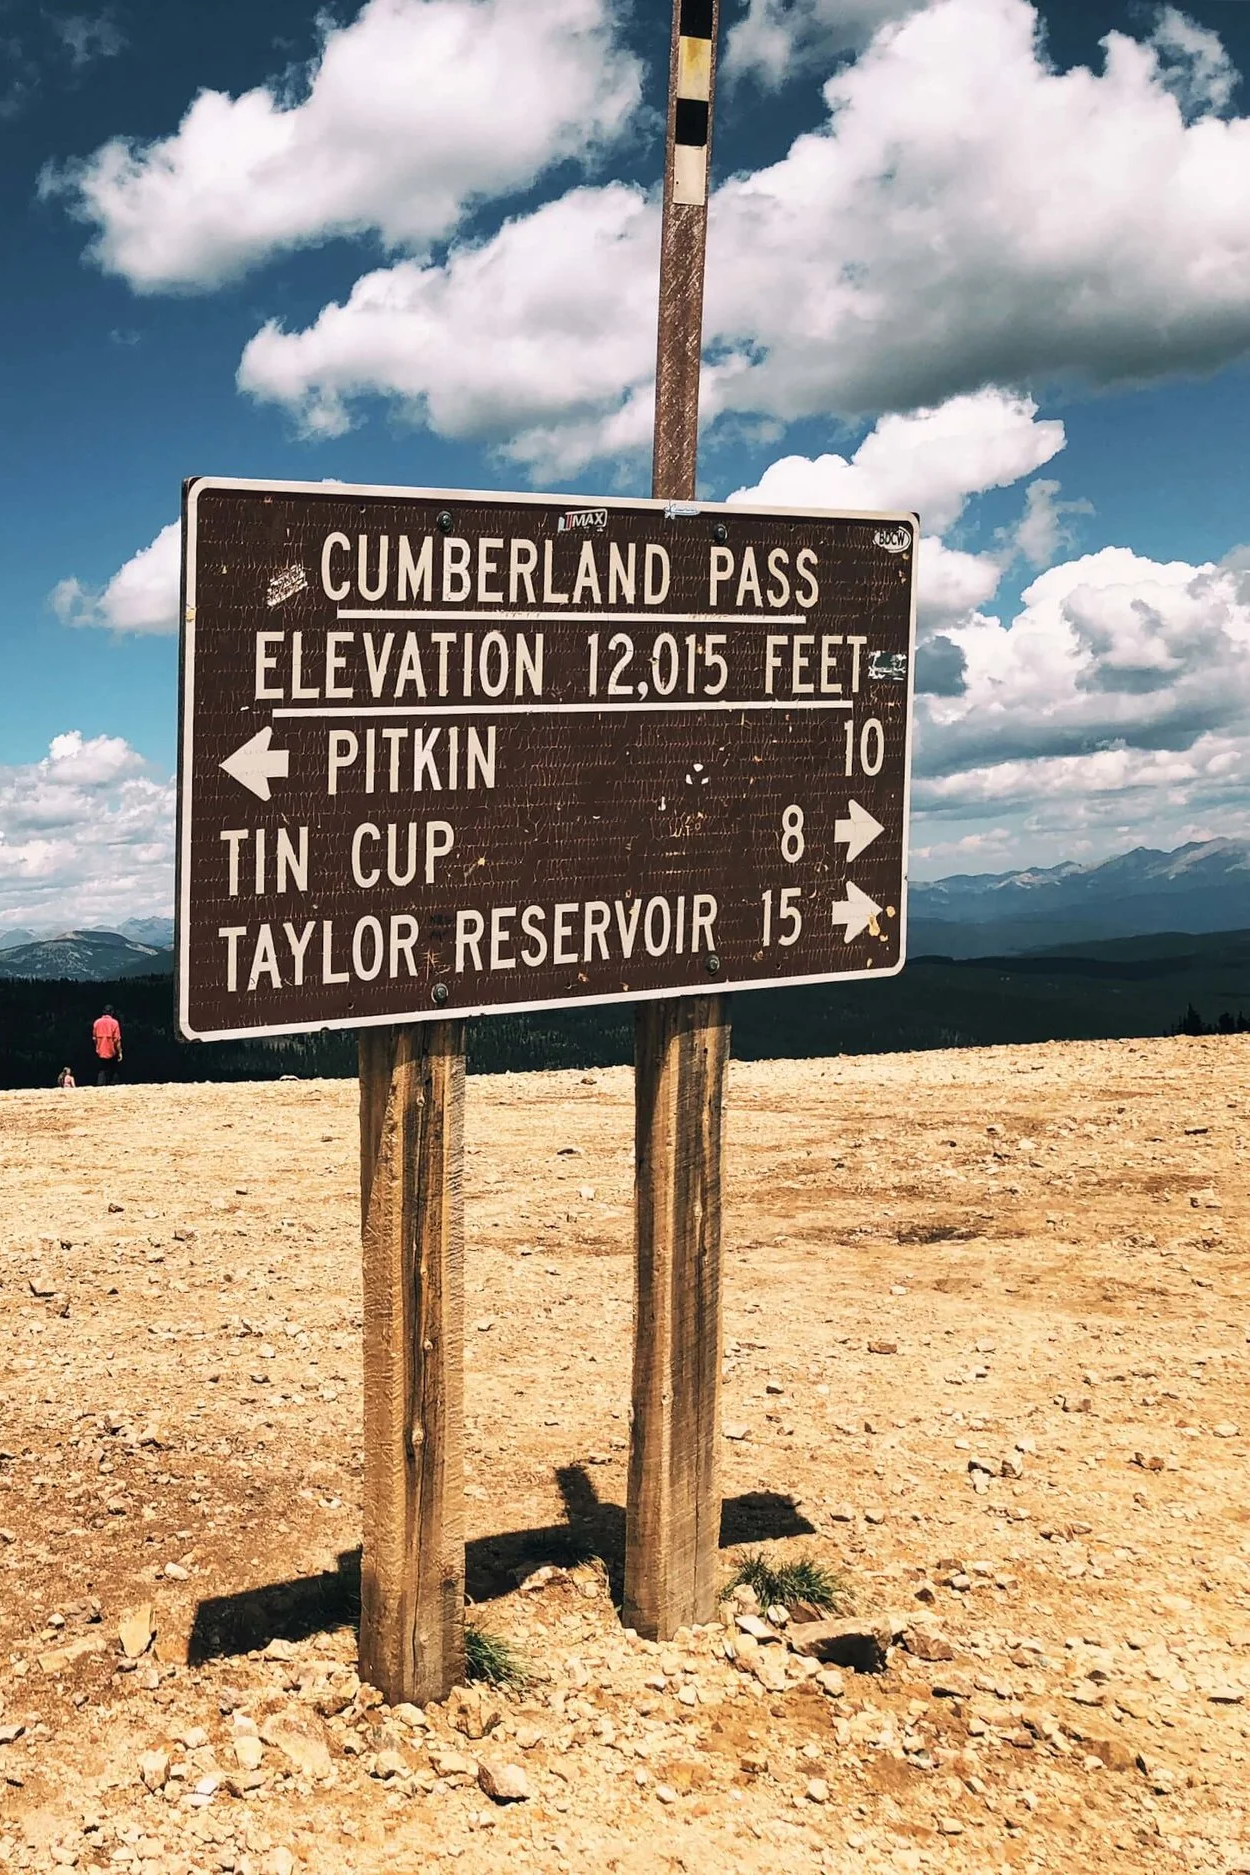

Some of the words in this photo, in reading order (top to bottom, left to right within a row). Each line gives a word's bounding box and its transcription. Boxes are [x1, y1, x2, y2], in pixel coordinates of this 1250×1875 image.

[322, 532, 670, 605] CUMBERLAND
[710, 547, 819, 608] PASS
[255, 630, 544, 700] ELEVATION
[588, 633, 728, 701] 12,015
[766, 634, 868, 694] FEET
[328, 726, 497, 796] PITKIN
[845, 718, 885, 777] 10
[220, 827, 309, 896] TIN
[352, 821, 455, 888] CUP
[781, 805, 805, 864] 8
[219, 915, 419, 992] TAYLOR
[455, 894, 718, 973] RESERVOIR
[762, 888, 802, 947] 15
